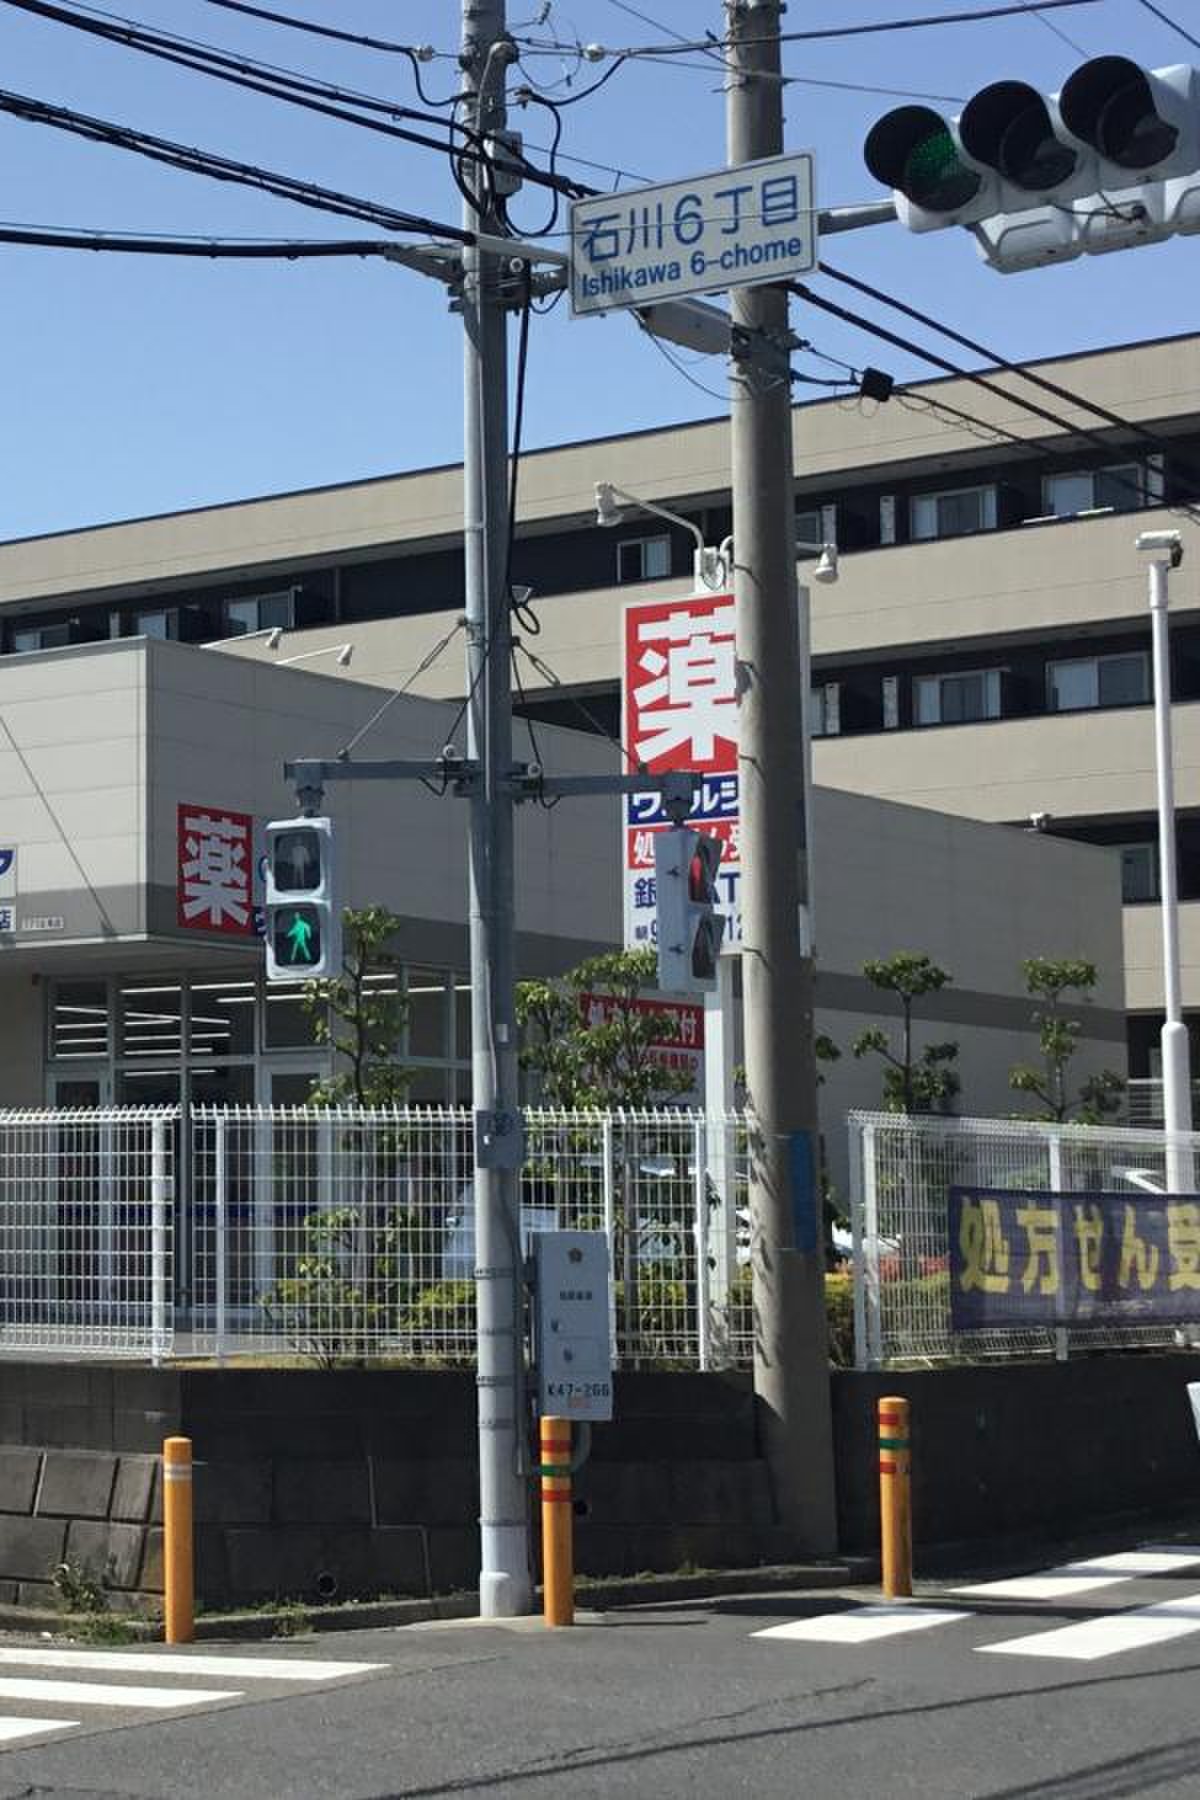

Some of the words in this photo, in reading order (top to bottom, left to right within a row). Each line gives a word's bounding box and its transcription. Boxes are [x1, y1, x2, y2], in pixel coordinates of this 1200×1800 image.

[582, 175, 798, 262] 石川6丁目
[582, 262, 681, 298] Ishikawa
[691, 237, 801, 276] 6-chome
[634, 609, 739, 761] 薬
[182, 815, 250, 927] 薬
